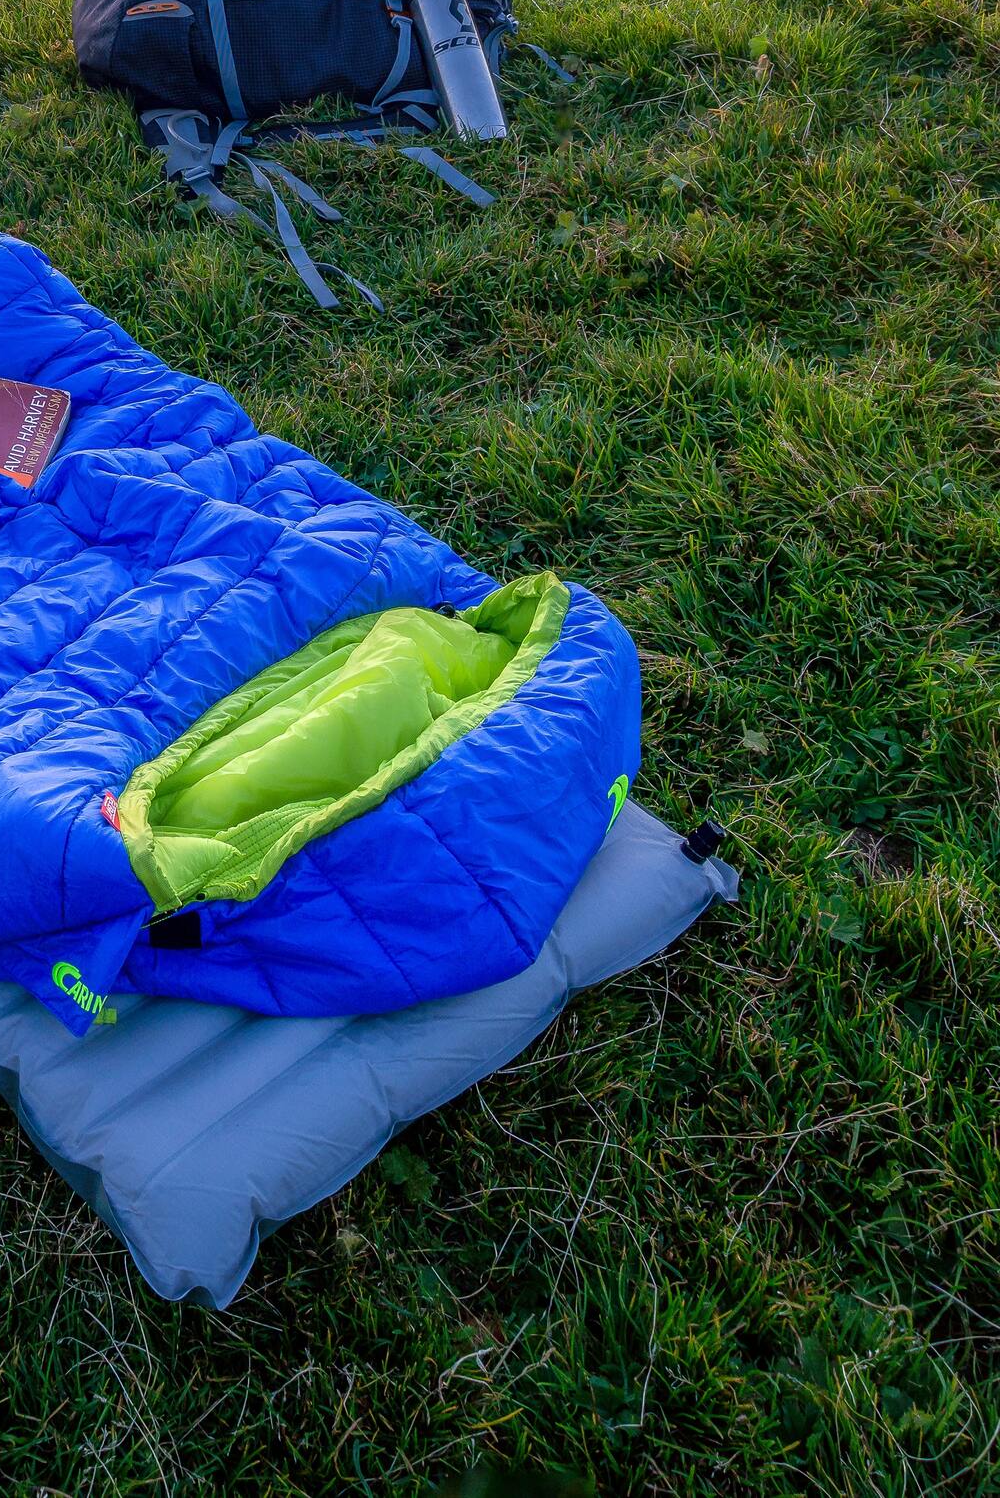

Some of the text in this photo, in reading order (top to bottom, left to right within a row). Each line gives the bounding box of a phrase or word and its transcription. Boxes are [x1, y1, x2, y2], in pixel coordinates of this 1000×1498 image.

[4, 391, 48, 472] AVID HARVEY
[24, 448, 41, 468] NEW
[33, 392, 62, 448] IMPERIALISM
